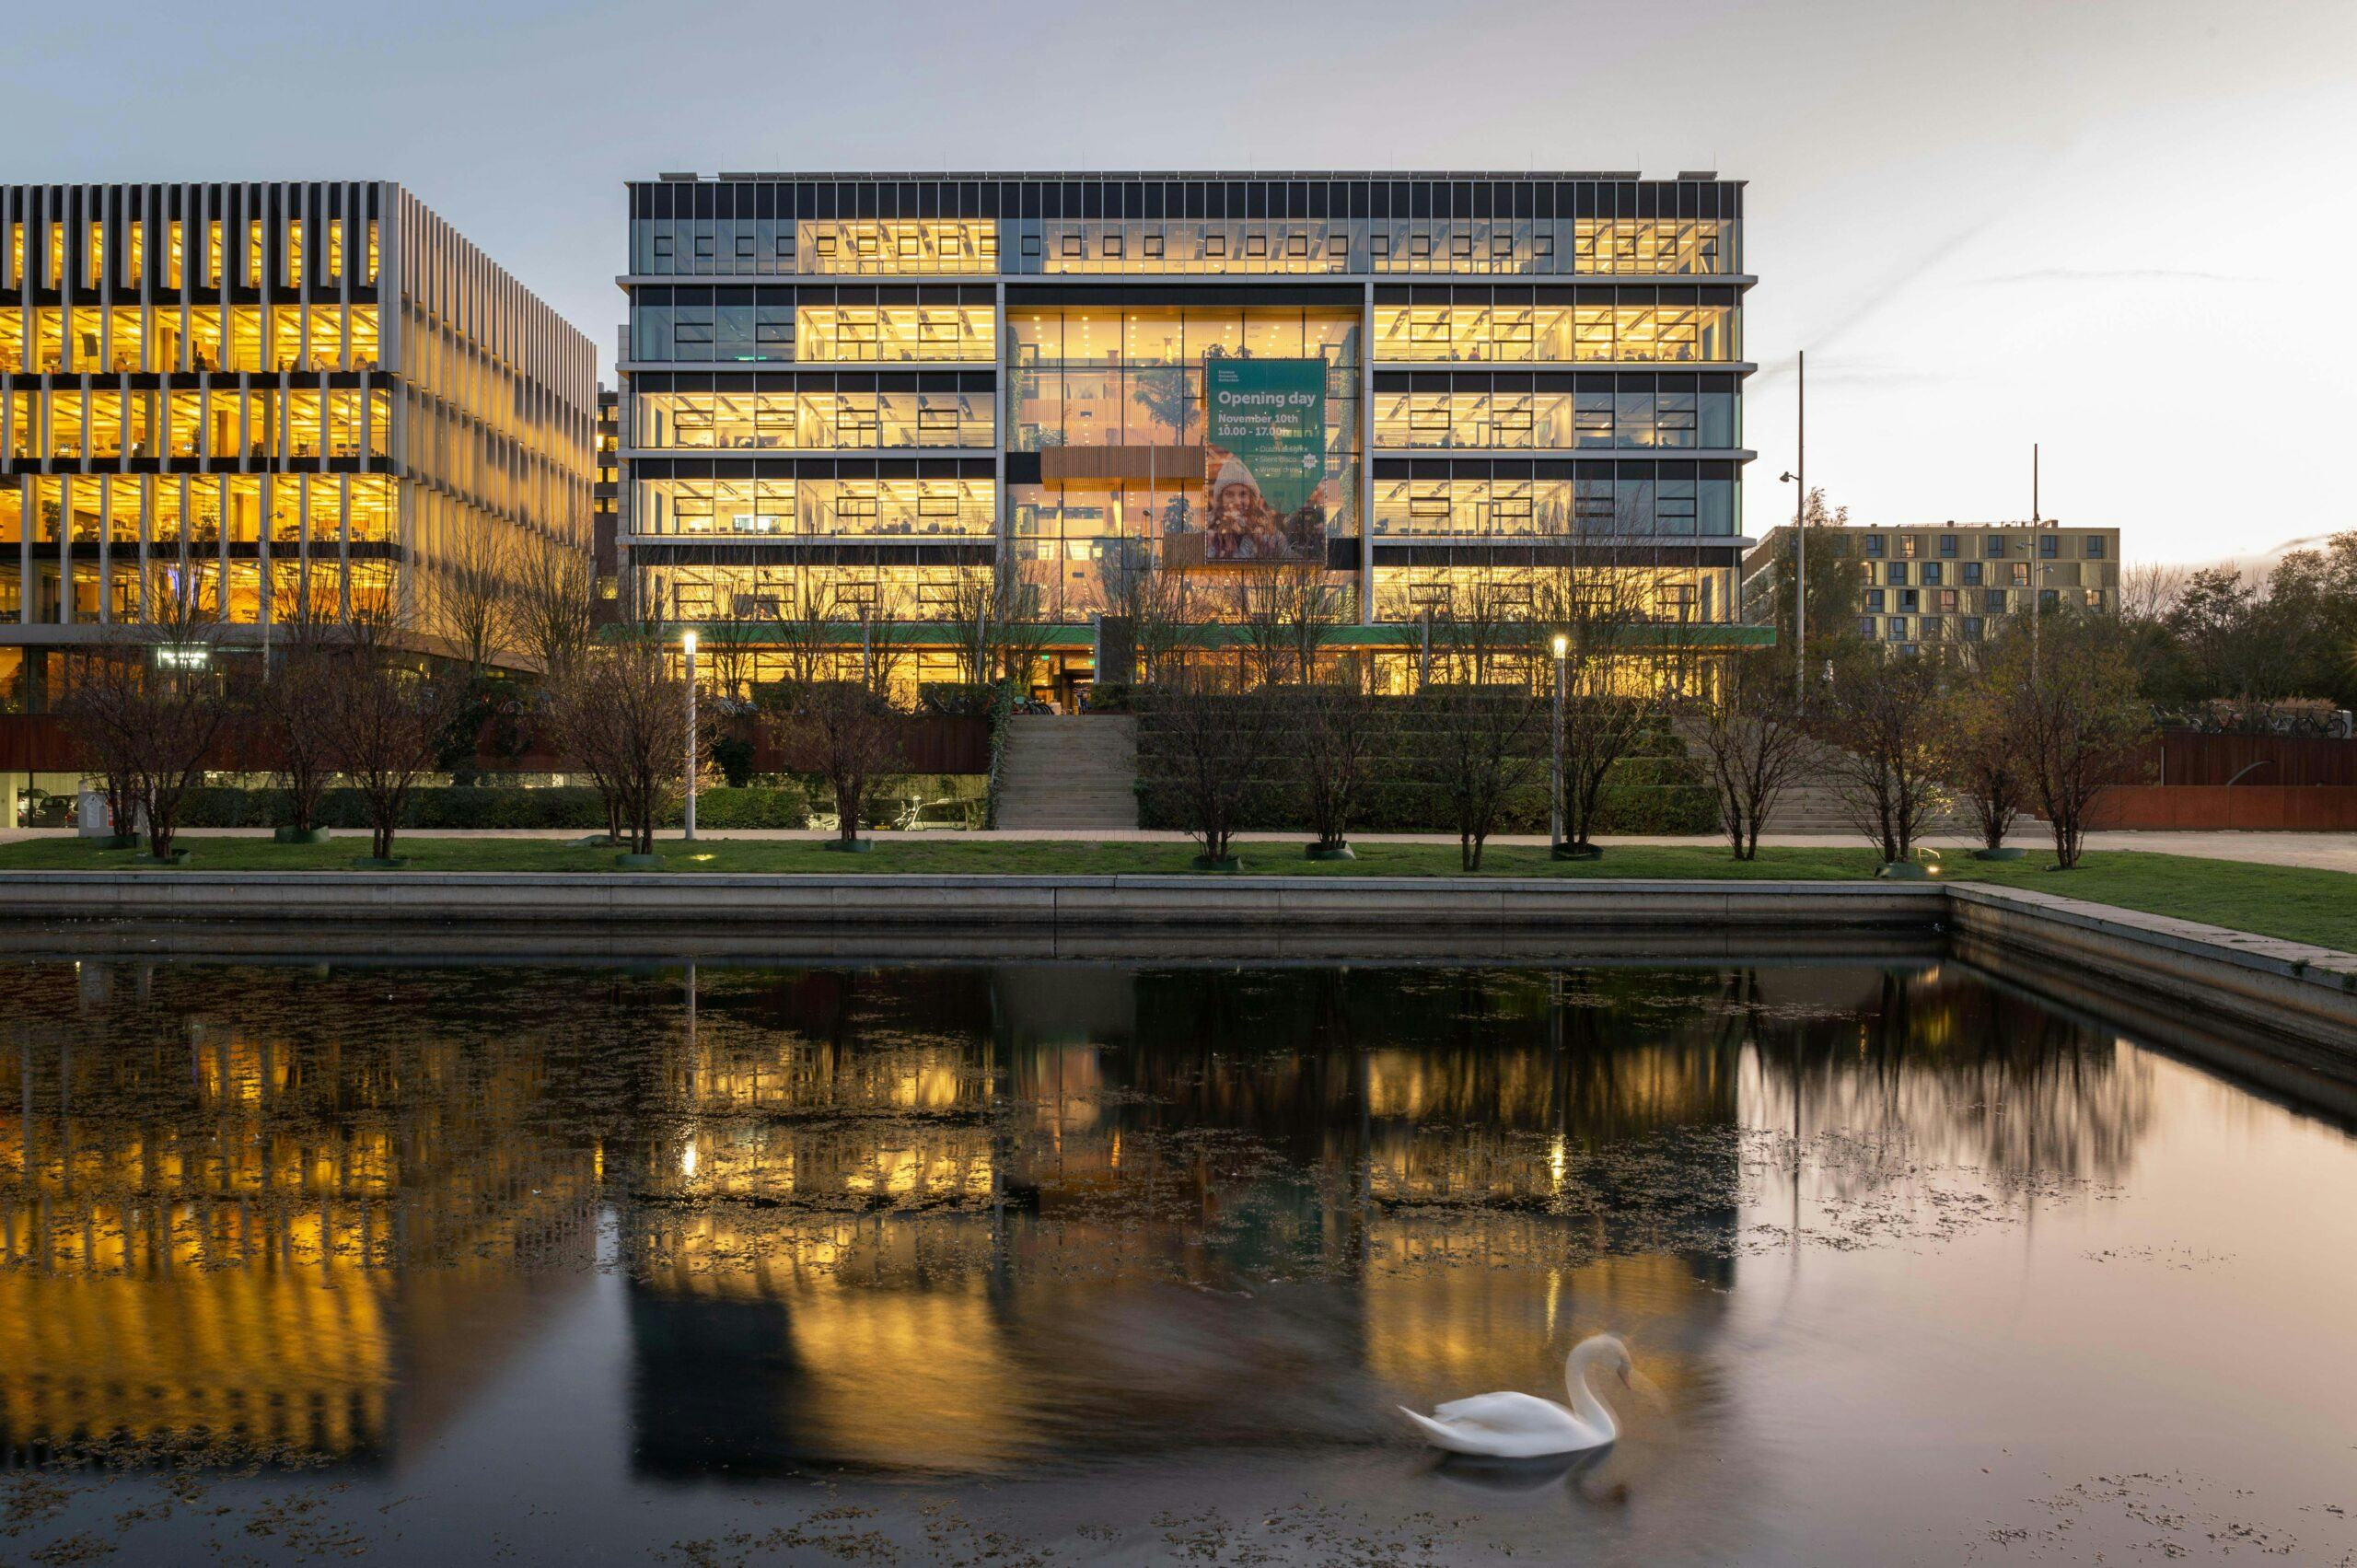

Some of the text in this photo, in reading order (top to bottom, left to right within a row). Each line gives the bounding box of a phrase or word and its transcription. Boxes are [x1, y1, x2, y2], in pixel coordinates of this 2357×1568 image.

[1218, 390, 1316, 408] Opening day
[1218, 413, 1298, 423] November 10th
[1218, 426, 1246, 436] 10.00
